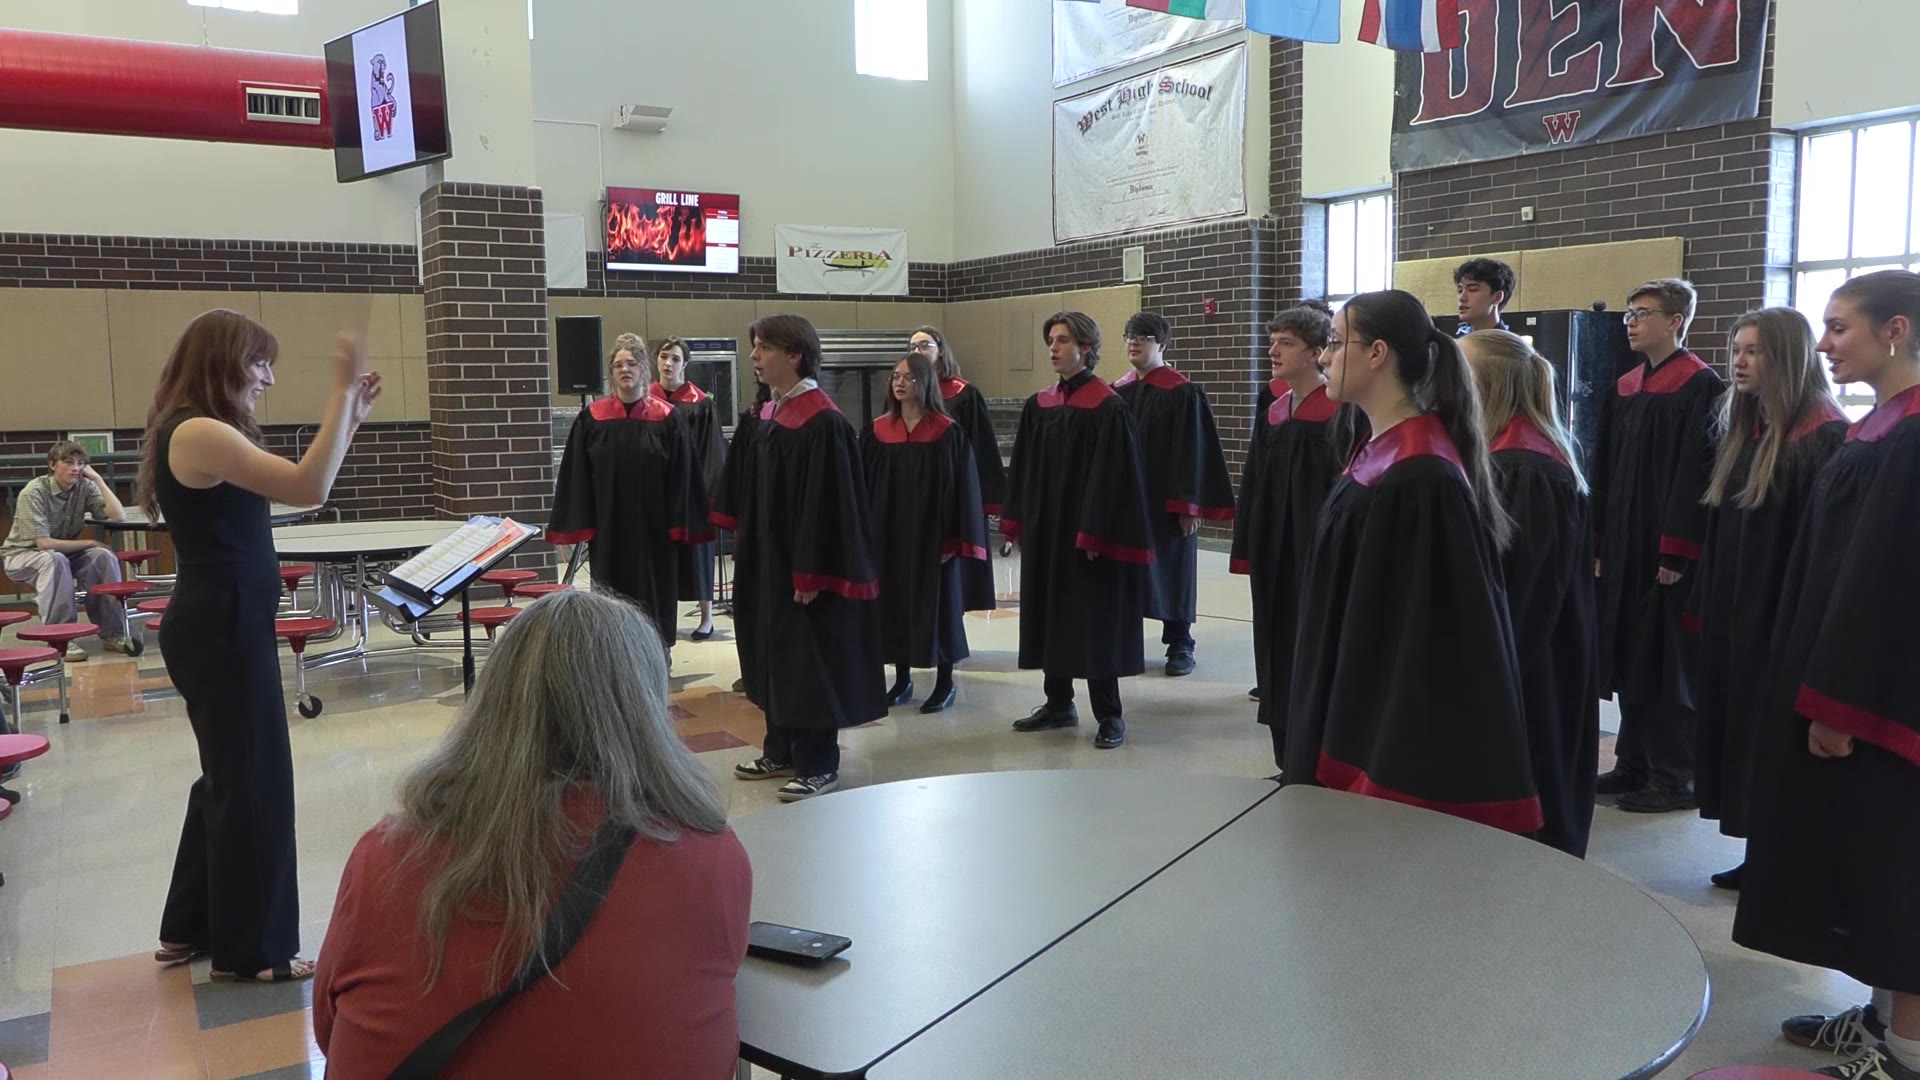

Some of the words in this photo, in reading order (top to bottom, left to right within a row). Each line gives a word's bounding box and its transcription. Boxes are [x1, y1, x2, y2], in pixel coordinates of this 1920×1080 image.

[373, 102, 394, 139] W
[1077, 100, 1112, 136] West
[1158, 76, 1213, 100] School
[1543, 111, 1580, 144] W
[655, 192, 678, 206] GRILL
[681, 193, 699, 206] LINE
[787, 245, 893, 260] PIZZERIA
